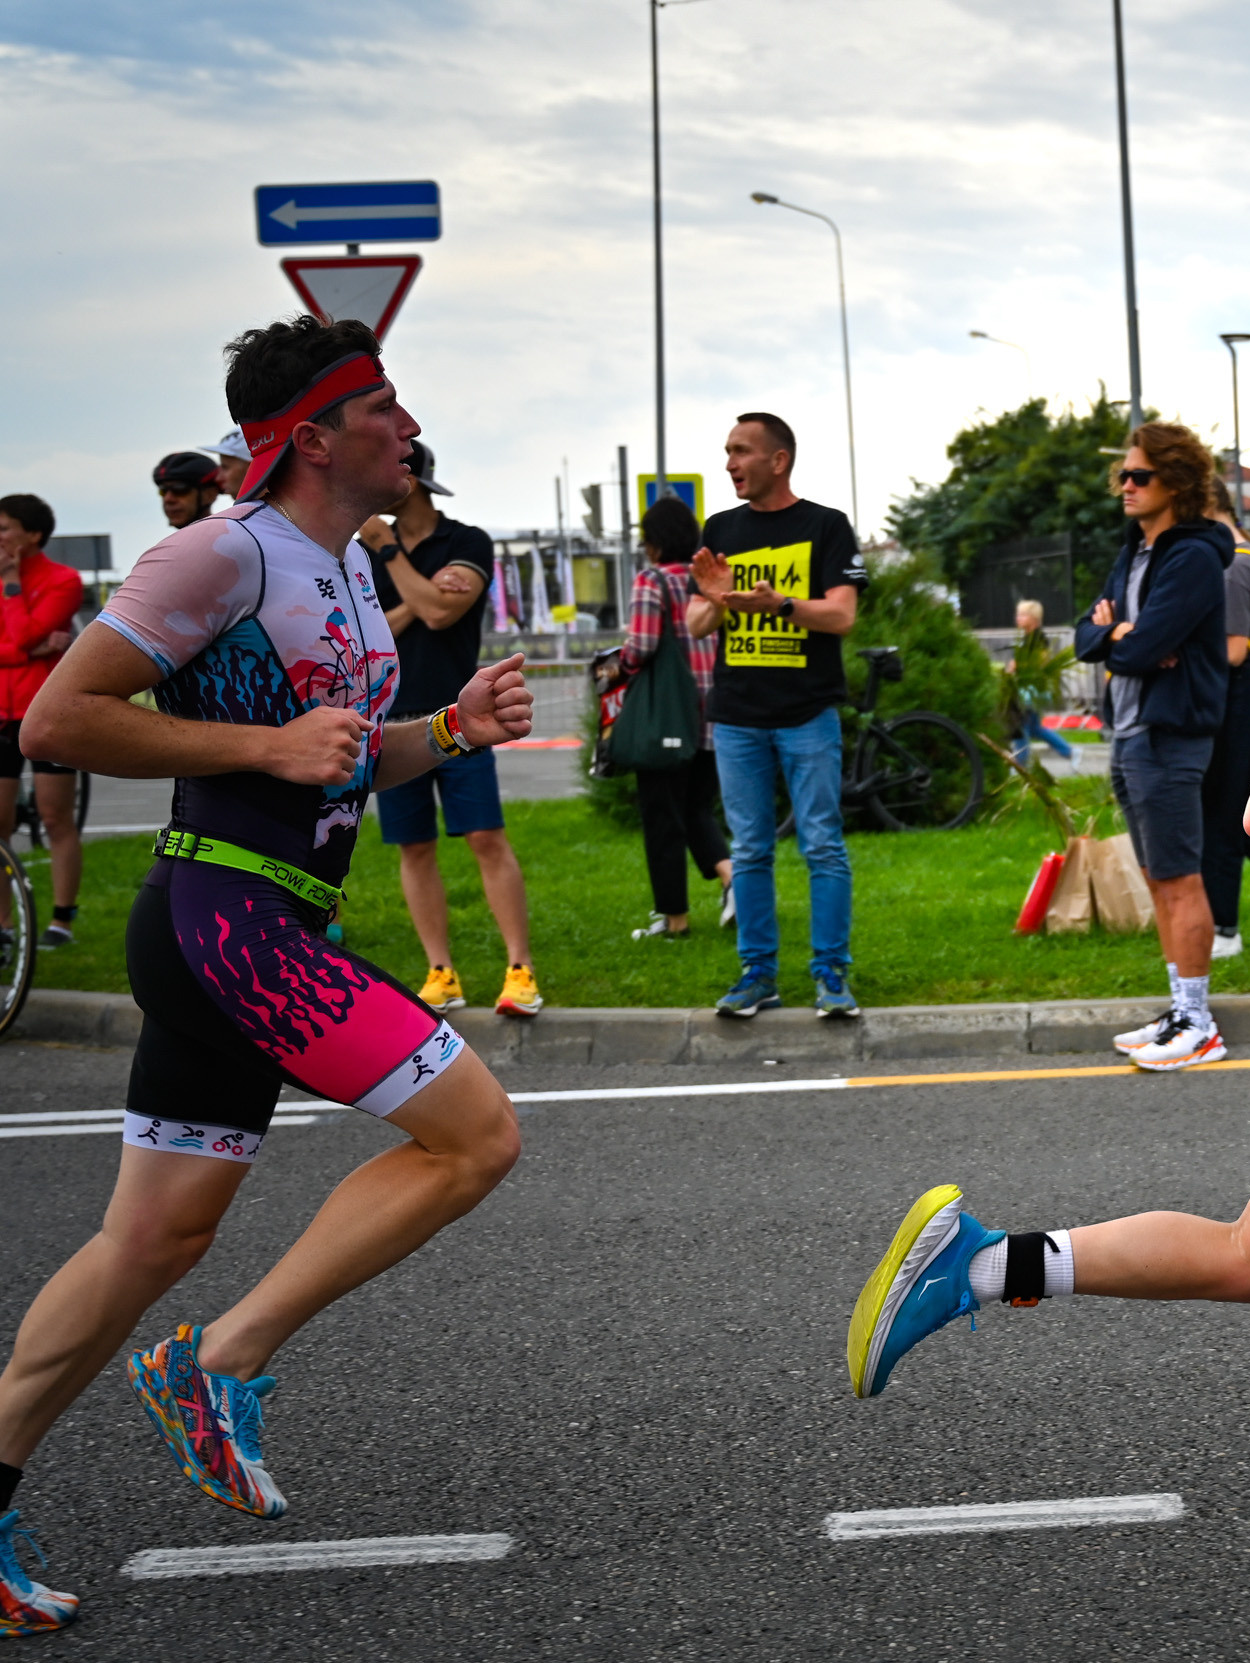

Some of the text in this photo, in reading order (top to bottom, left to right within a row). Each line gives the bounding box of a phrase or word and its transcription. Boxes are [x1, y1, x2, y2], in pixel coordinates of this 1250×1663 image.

[251, 430, 276, 451] 2XU
[732, 564, 776, 590] RON
[729, 636, 756, 654] 226
